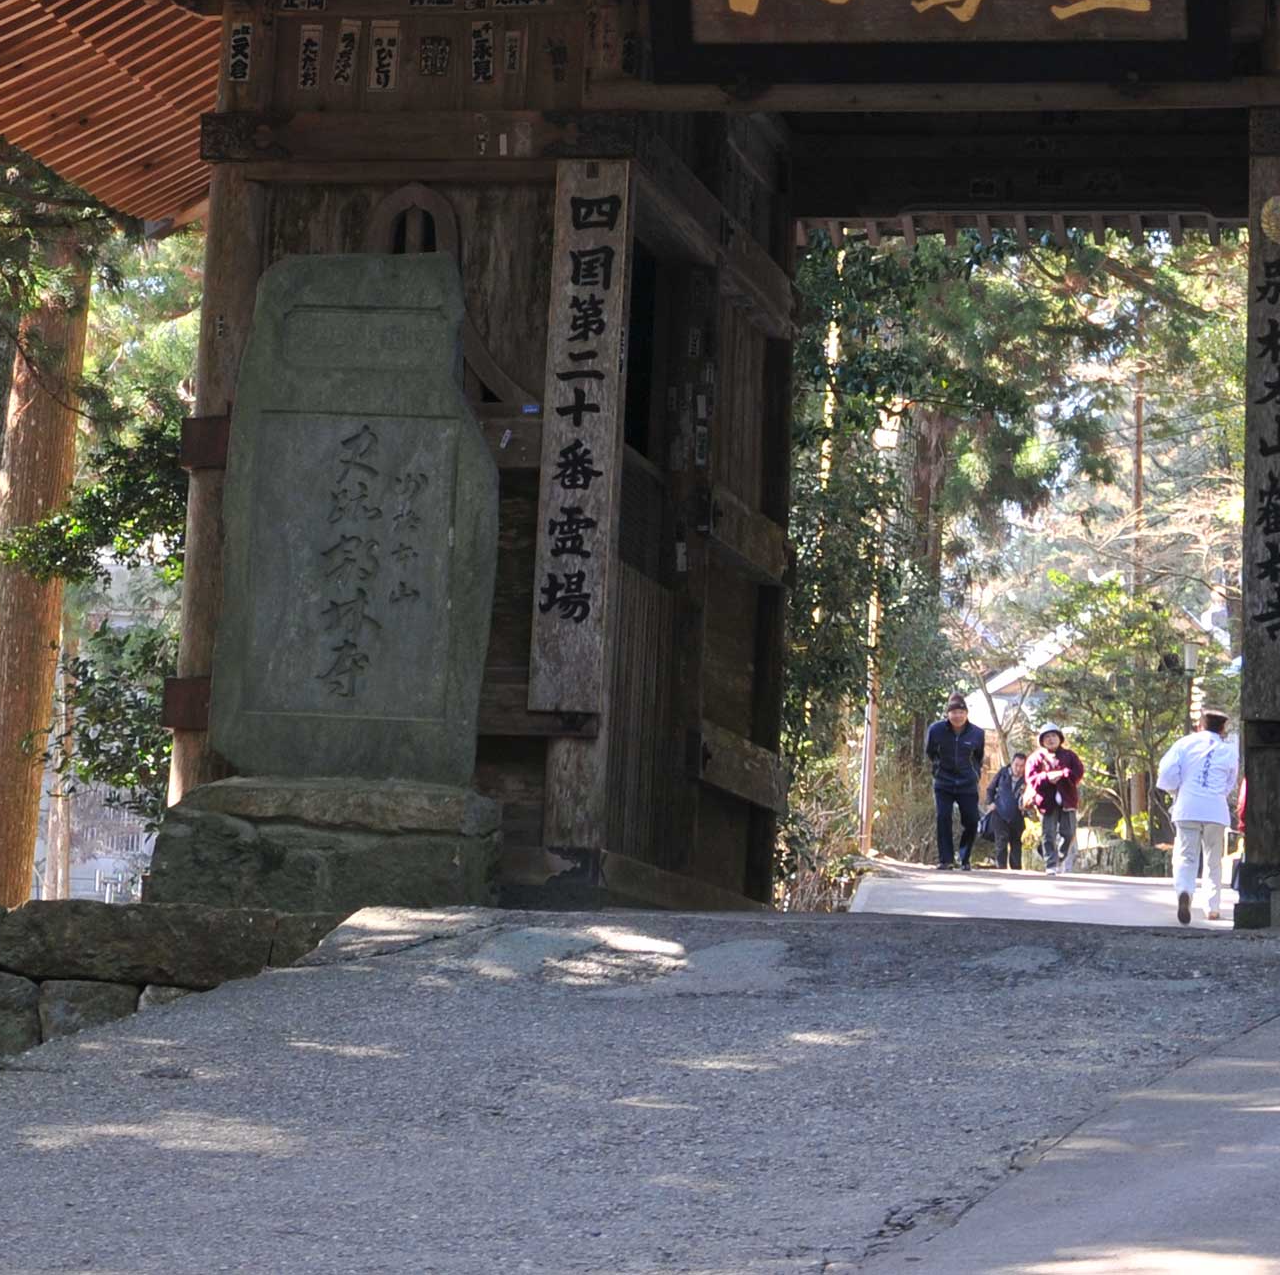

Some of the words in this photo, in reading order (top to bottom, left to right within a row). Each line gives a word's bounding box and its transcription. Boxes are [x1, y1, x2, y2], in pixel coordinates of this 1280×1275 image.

[539, 193, 621, 623] 四国第二十番霊場
